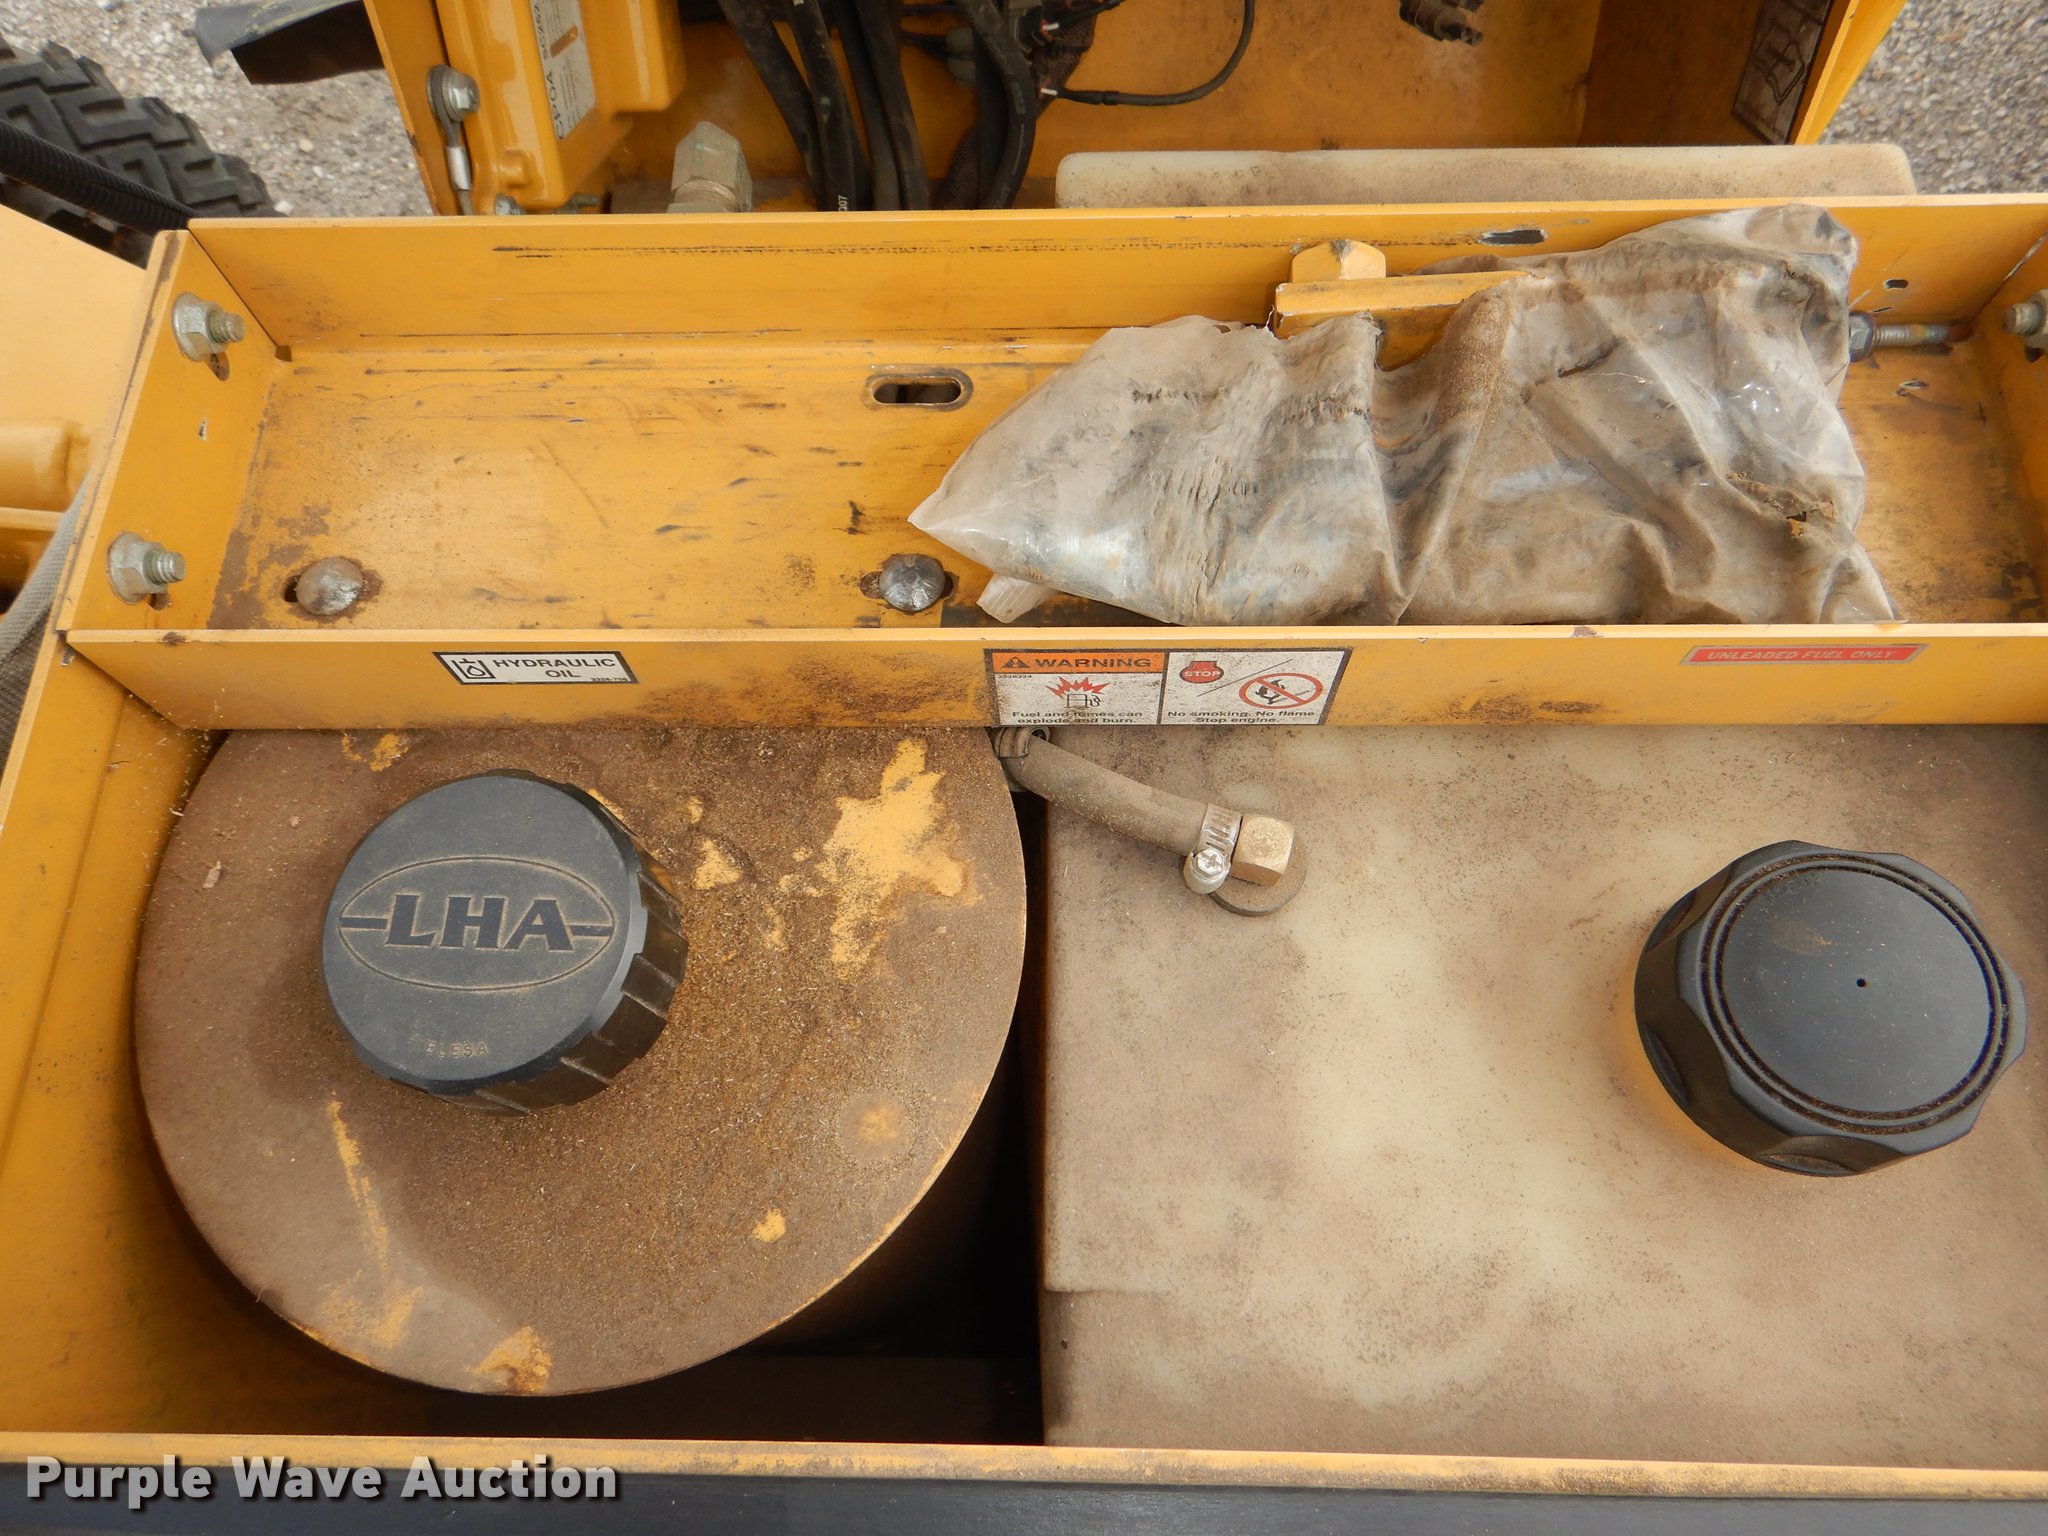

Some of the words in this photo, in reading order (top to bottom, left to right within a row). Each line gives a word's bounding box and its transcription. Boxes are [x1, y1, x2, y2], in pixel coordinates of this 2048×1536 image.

[1707, 651, 1798, 660] UNLEADED
[1803, 651, 1846, 659] FUEL
[493, 658, 616, 668] HYDRAULIC
[1034, 658, 1152, 668] WARNING
[545, 670, 581, 678] OIL
[385, 894, 574, 951] LHA
